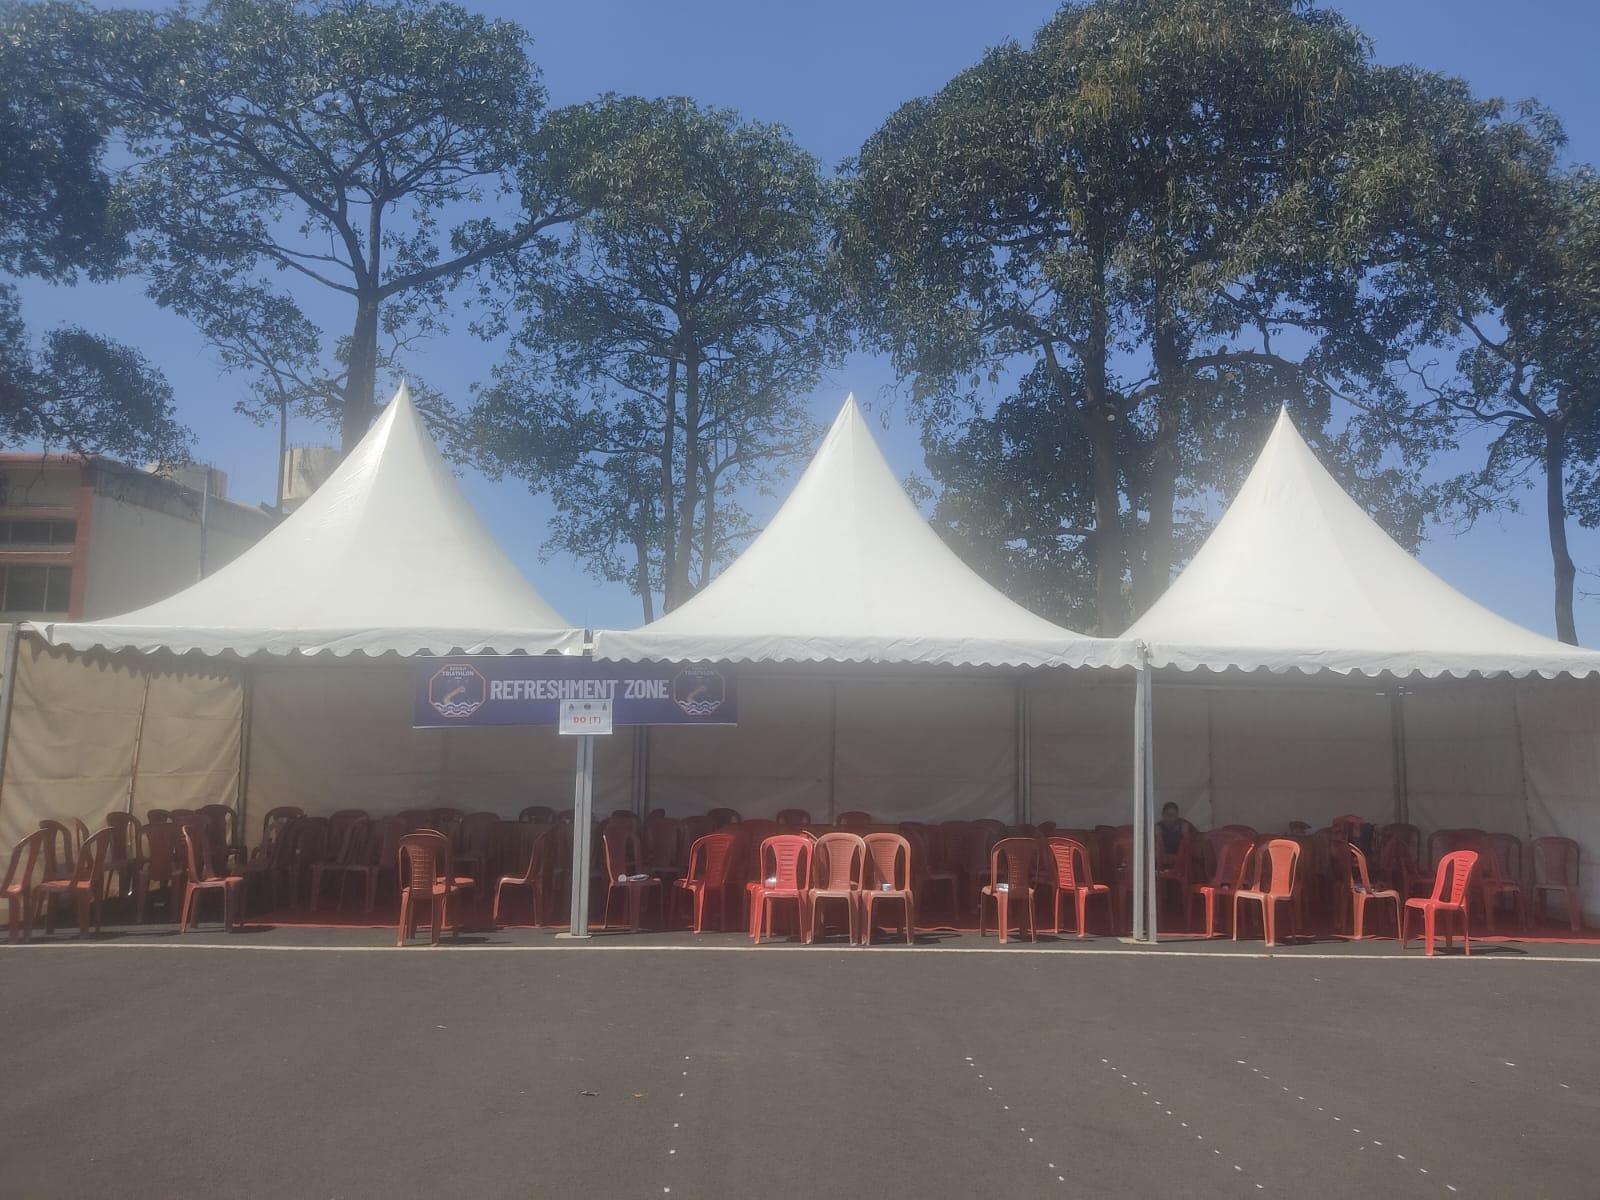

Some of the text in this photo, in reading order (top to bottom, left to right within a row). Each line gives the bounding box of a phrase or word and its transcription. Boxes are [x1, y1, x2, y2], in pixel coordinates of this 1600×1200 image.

[490, 679, 669, 700] REFRESHMENT ZONE
[573, 716, 587, 724] DO
